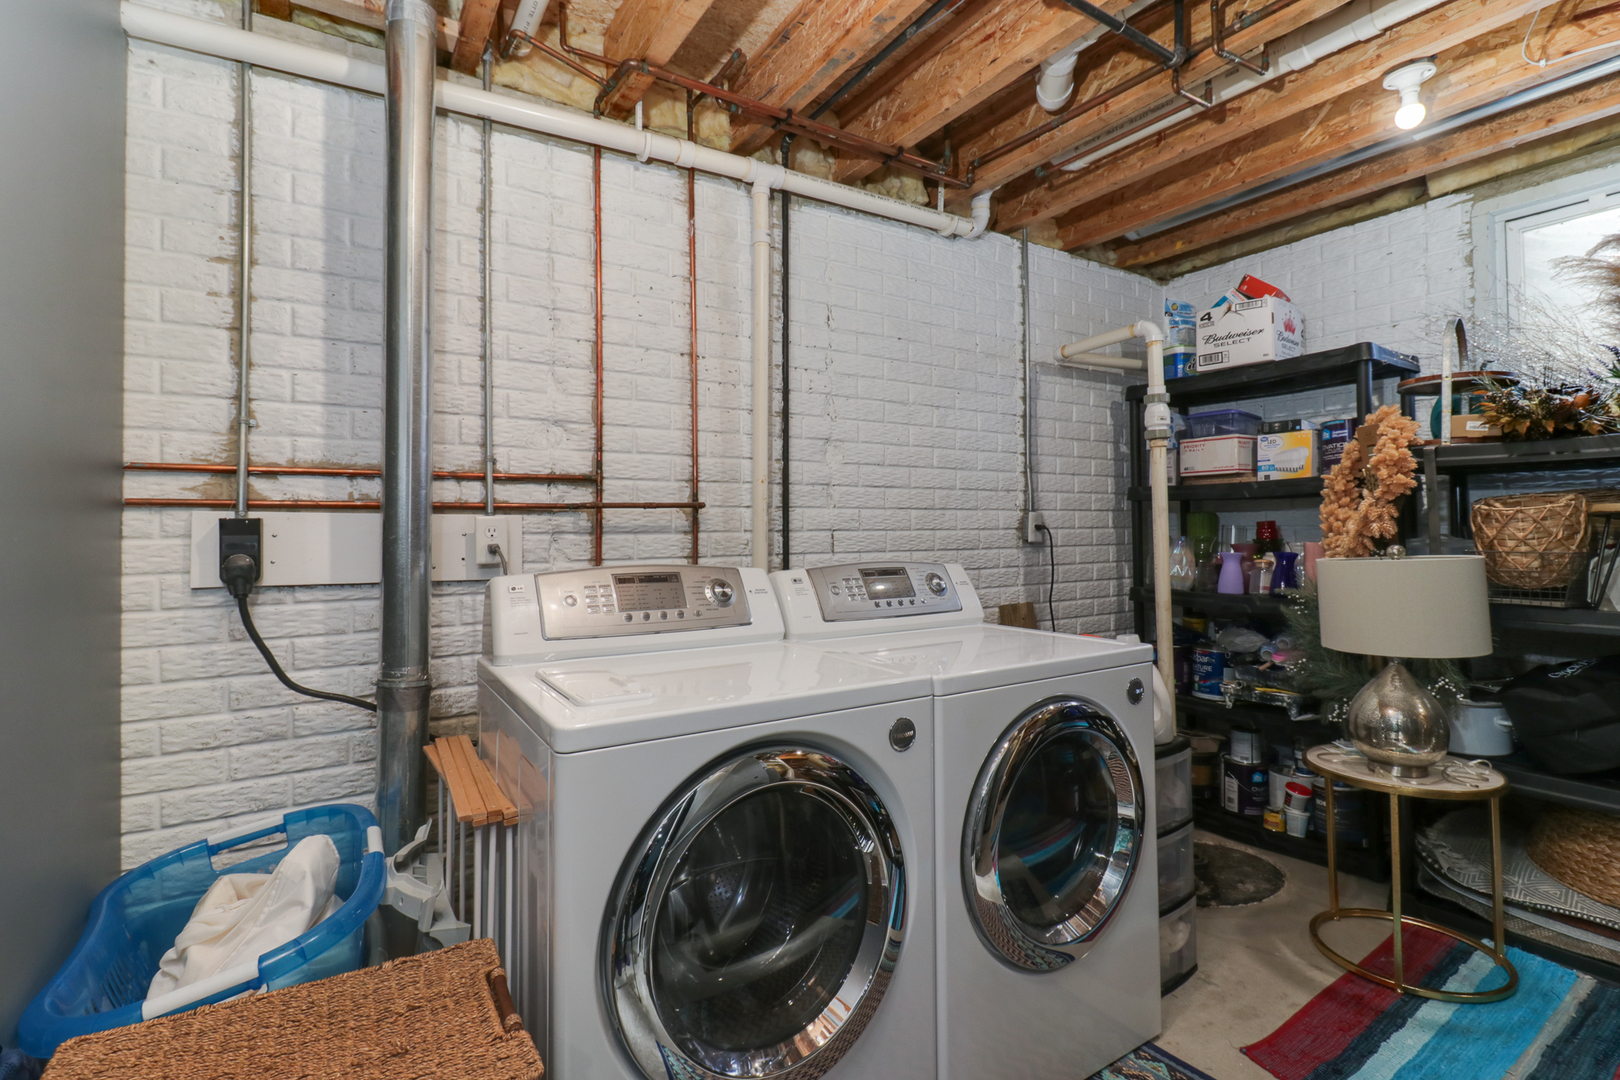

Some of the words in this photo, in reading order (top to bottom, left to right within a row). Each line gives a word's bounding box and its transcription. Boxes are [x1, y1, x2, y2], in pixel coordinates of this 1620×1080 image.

[1200, 311, 1213, 322] 4
[1202, 328, 1265, 345] Budweiser
[1213, 337, 1252, 348] SELECT
